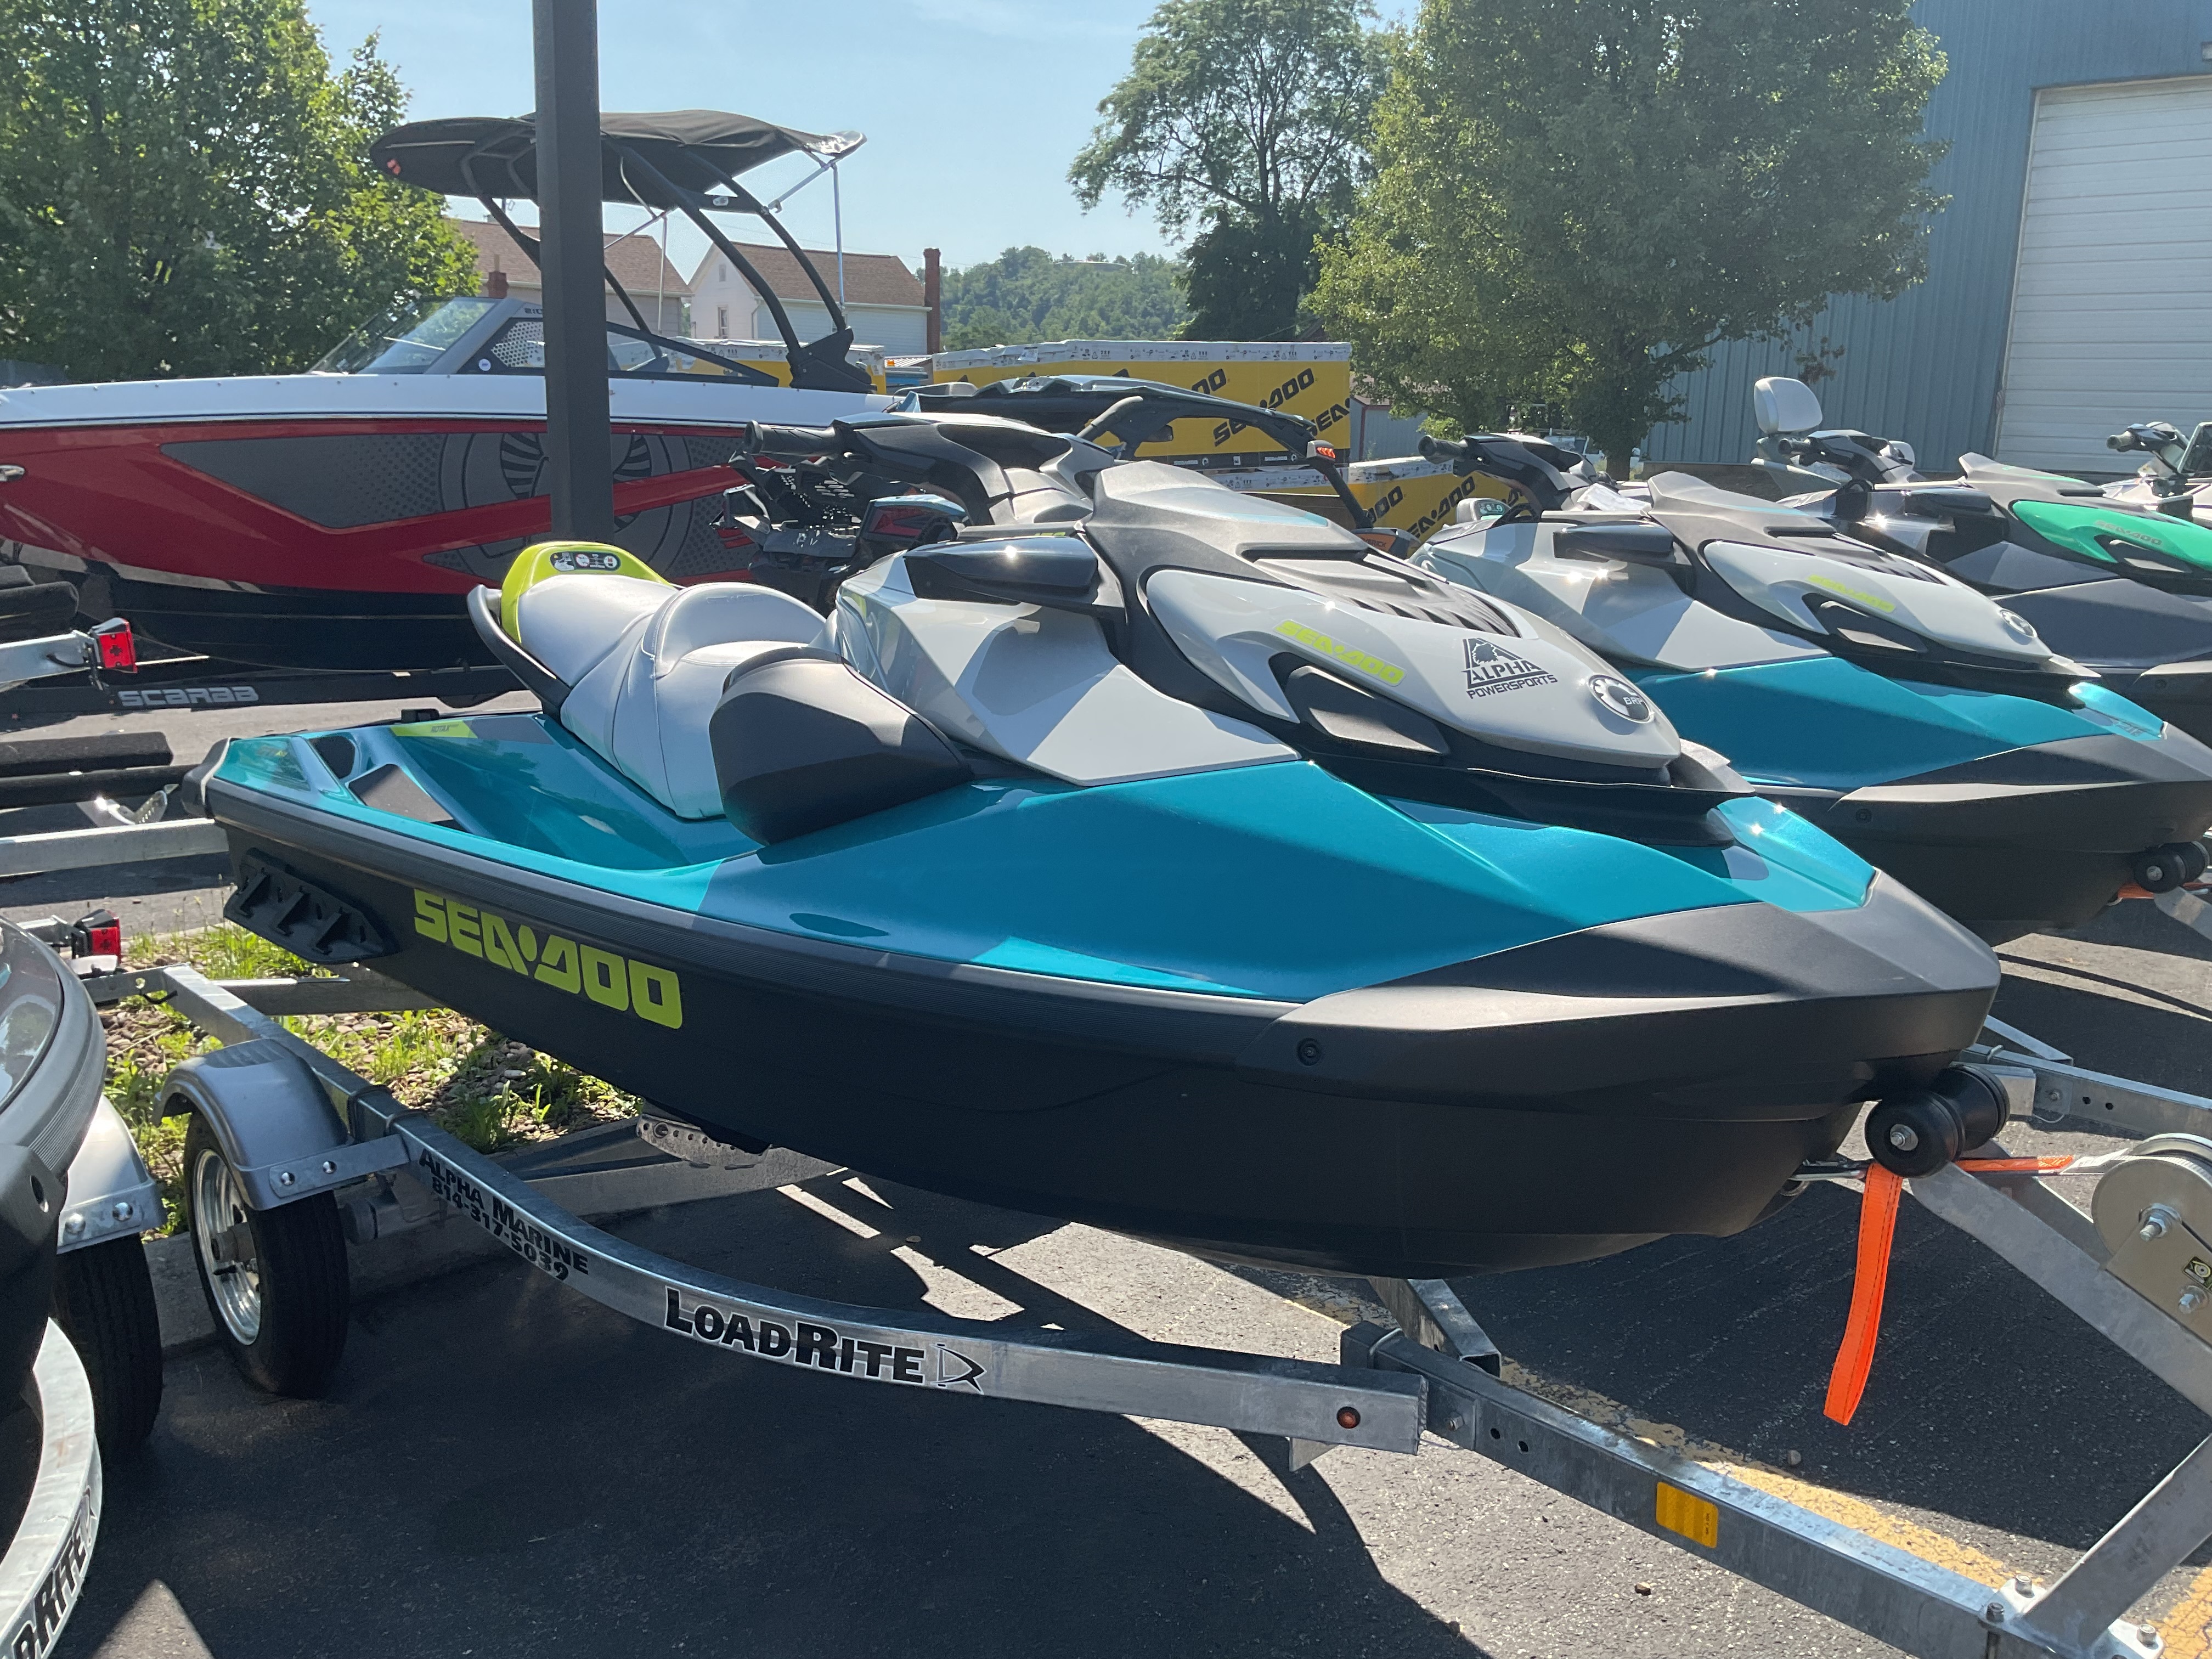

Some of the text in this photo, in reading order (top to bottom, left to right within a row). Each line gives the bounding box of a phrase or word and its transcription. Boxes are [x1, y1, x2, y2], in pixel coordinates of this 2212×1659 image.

[1470, 659, 1542, 682] ALPHA
[118, 686, 259, 707] SCARAB
[1466, 674, 1558, 699] POWERSPORTS
[1623, 696, 1643, 705] BRP
[418, 1147, 589, 1276] ALPHA MARINE
